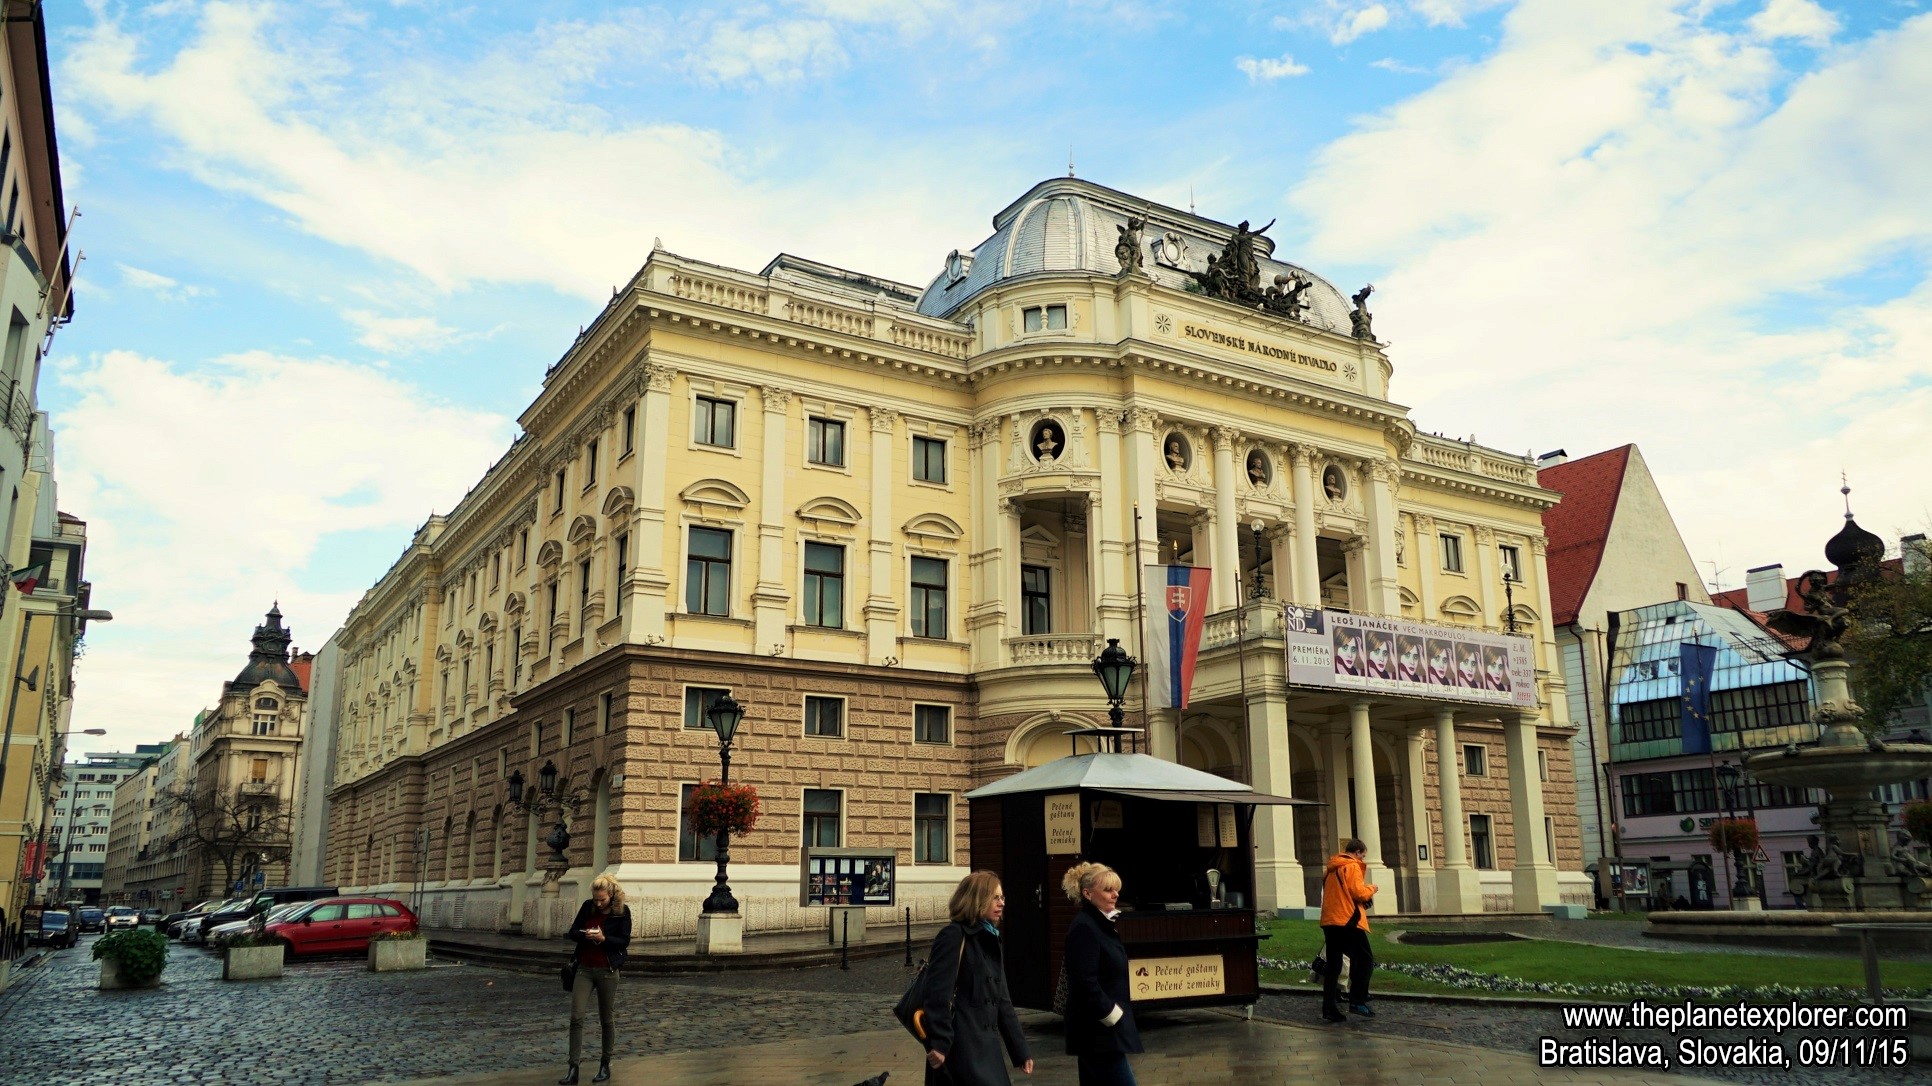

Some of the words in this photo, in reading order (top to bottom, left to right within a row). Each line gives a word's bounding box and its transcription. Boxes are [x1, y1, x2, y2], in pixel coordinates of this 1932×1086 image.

[1184, 325, 1245, 351] SLOVENSKÉ
[1248, 340, 1297, 363] NÁRODNÉ
[1297, 353, 1338, 373] DIVADLO
[1331, 616, 1354, 626] LEOŠ
[1358, 618, 1399, 632] JANÁČEK
[1402, 625, 1416, 634] VEC
[1419, 627, 1466, 641] MAKROPULOS
[1292, 645, 1330, 656] PREMIÉRA
[1314, 656, 1331, 666] 2015
[1051, 802, 1073, 811] Pečené
[1049, 811, 1075, 821] gaštany
[1052, 828, 1074, 836] Pečené
[1050, 835, 1076, 846] zemiaky
[1155, 965, 1183, 977] Pečené
[1185, 963, 1218, 977] gaštany
[1155, 980, 1184, 992] Pečené
[1187, 977, 1220, 991] zemiaky
